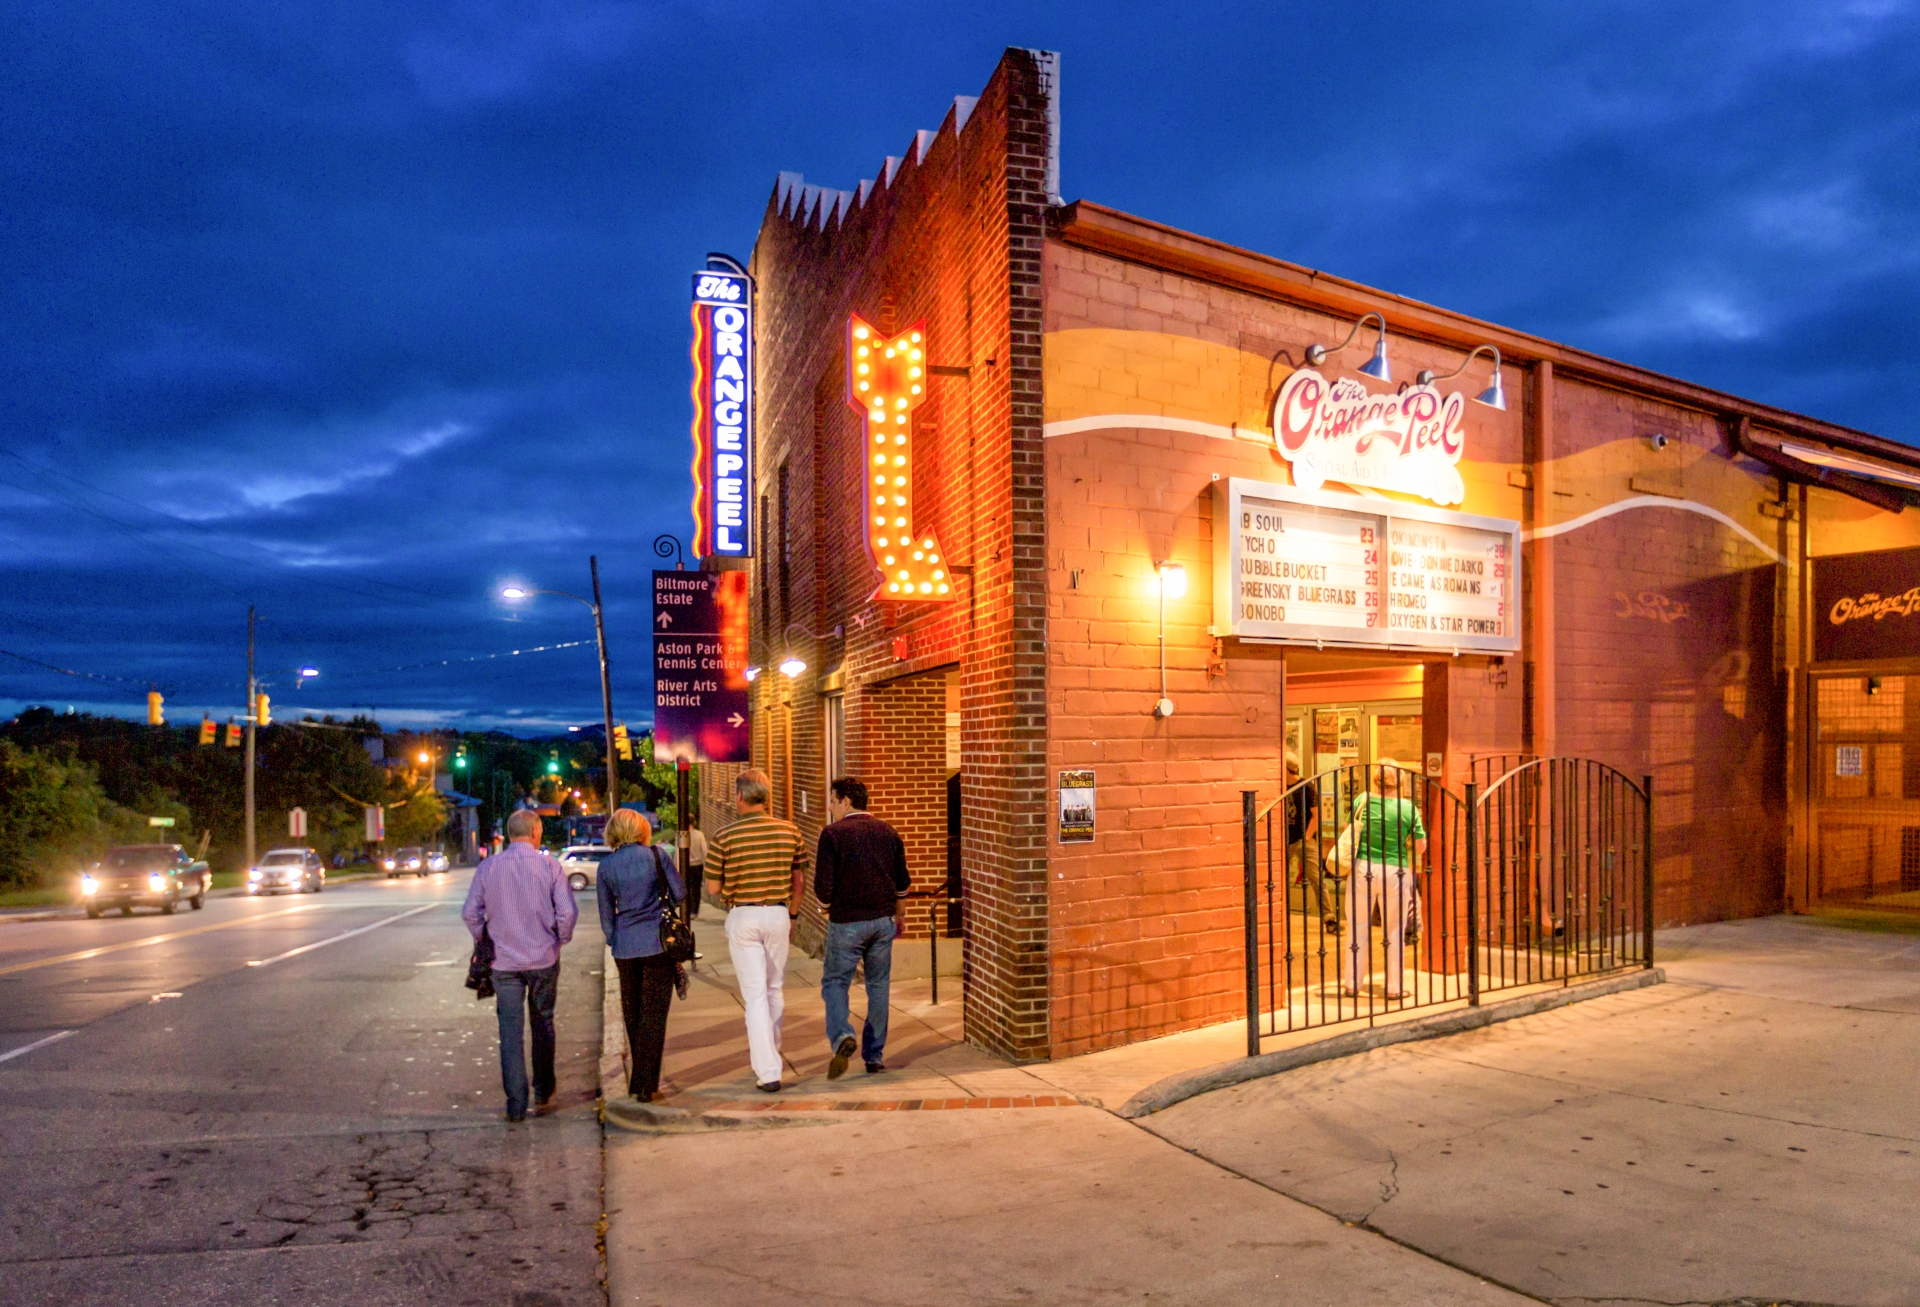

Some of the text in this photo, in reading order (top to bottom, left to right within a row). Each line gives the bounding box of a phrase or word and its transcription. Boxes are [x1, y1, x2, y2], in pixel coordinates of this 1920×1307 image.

[695, 276, 741, 302] The
[1332, 380, 1365, 403] The
[1280, 376, 1461, 457] Orange Peel
[713, 306, 745, 552] ORANGE PEEL
[1255, 514, 1286, 534] SOUL
[1360, 527, 1375, 544] 23
[1241, 535, 1378, 565] YCHO 24
[1390, 551, 1413, 568] OVIE
[1420, 554, 1452, 573] DONNIE
[1454, 559, 1484, 575] DARKO
[1493, 563, 1505, 578] 29
[655, 577, 709, 591] Biltmore
[1365, 570, 1378, 586] 25
[1390, 571, 1398, 587] E
[1400, 573, 1425, 590] CAME
[1430, 576, 1442, 592] AS
[1443, 577, 1482, 595] ROMANS
[655, 592, 694, 605] Estate
[1297, 585, 1357, 606] BLUEGRASS
[1365, 591, 1379, 607] 26
[1390, 592, 1504, 617] HROMEO 2
[1366, 612, 1378, 628] 27
[1829, 595, 1904, 625] Orange
[1390, 612, 1502, 636] OXYGEN & STAR POWER 3
[657, 642, 736, 655] Aston Park &
[657, 657, 741, 670] Tennis Center
[656, 679, 718, 692] River Arts
[656, 693, 701, 707] District
